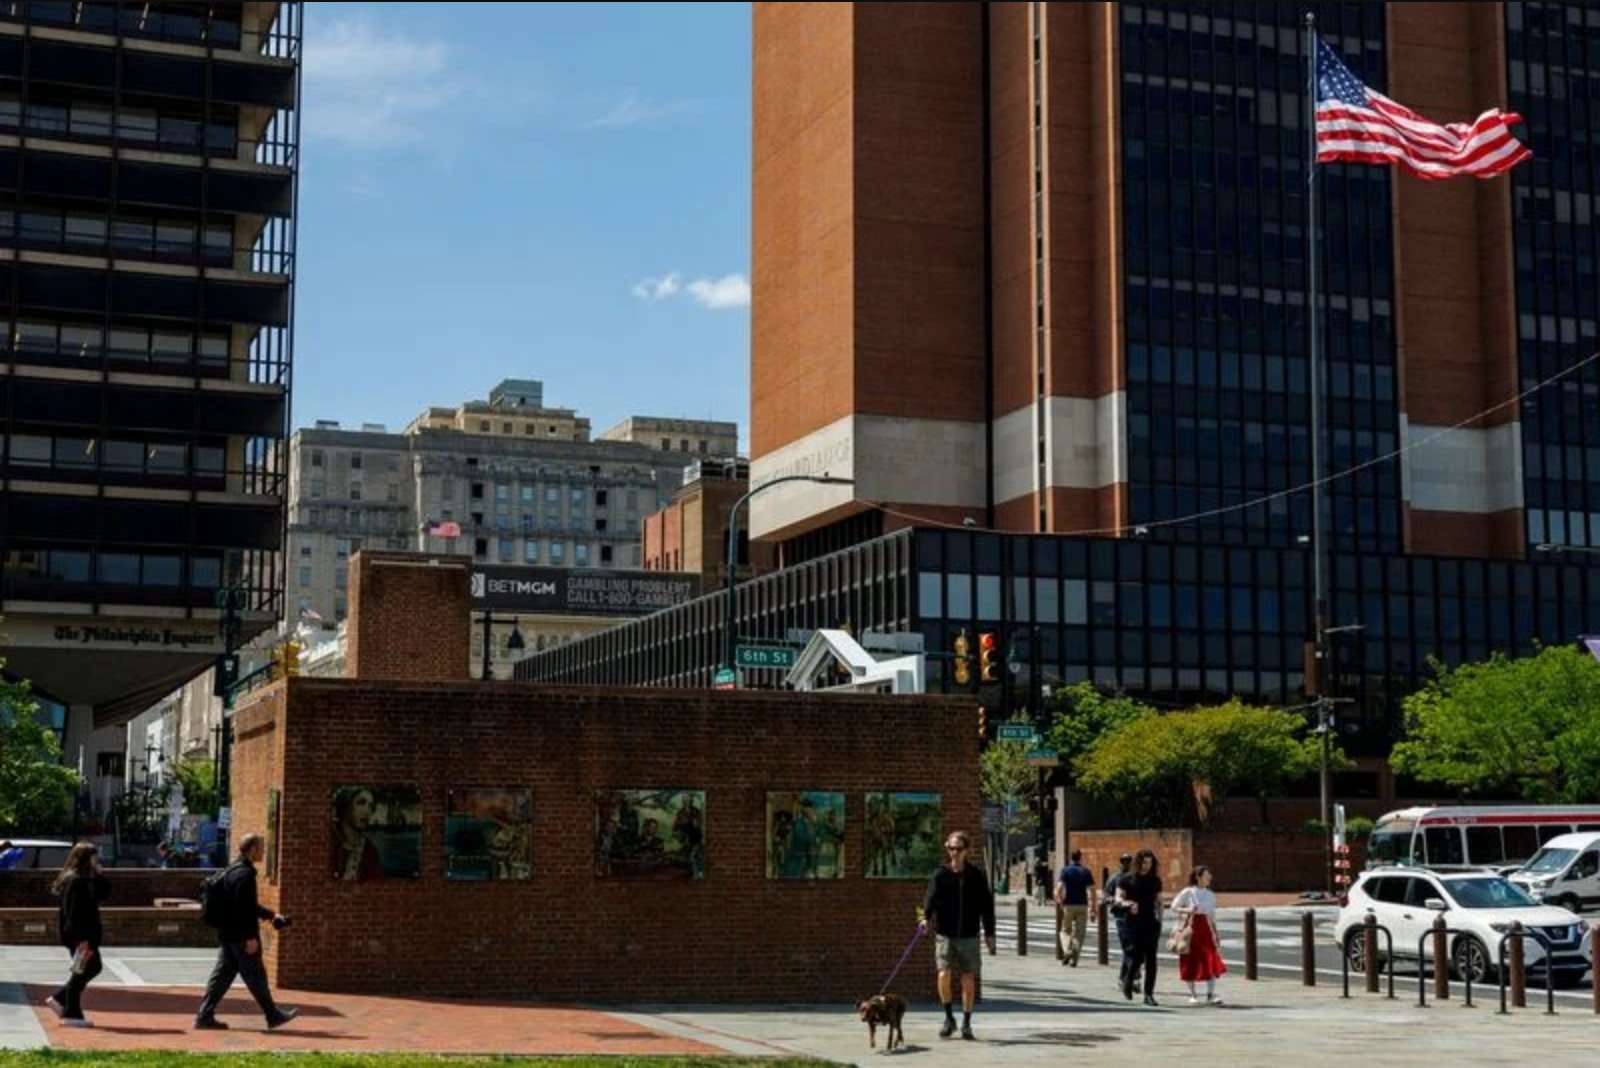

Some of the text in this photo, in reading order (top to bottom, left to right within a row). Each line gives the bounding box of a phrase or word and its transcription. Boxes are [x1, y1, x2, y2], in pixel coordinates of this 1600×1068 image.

[487, 579, 556, 595] BETMGM
[53, 625, 216, 648] The Philadelphia Inquirer
[743, 649, 788, 663] 6th St
